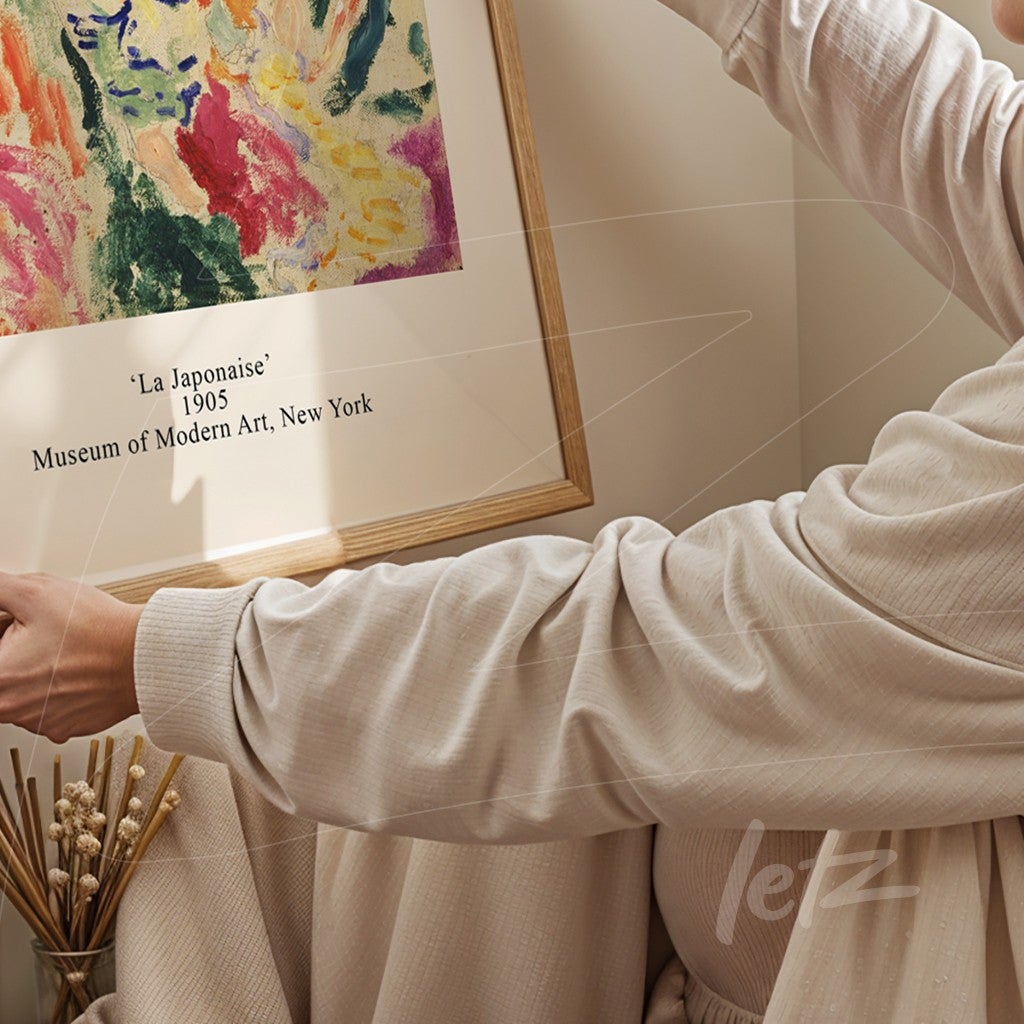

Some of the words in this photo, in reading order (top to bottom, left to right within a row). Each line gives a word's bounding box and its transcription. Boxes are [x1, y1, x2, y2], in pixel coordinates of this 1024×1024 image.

[183, 389, 228, 416] 1905
[32, 441, 121, 472] Museum
[127, 429, 150, 455] of
[154, 421, 231, 450] Modern
[238, 413, 275, 436] Art,
[279, 405, 323, 428] New
[327, 392, 374, 419] York
